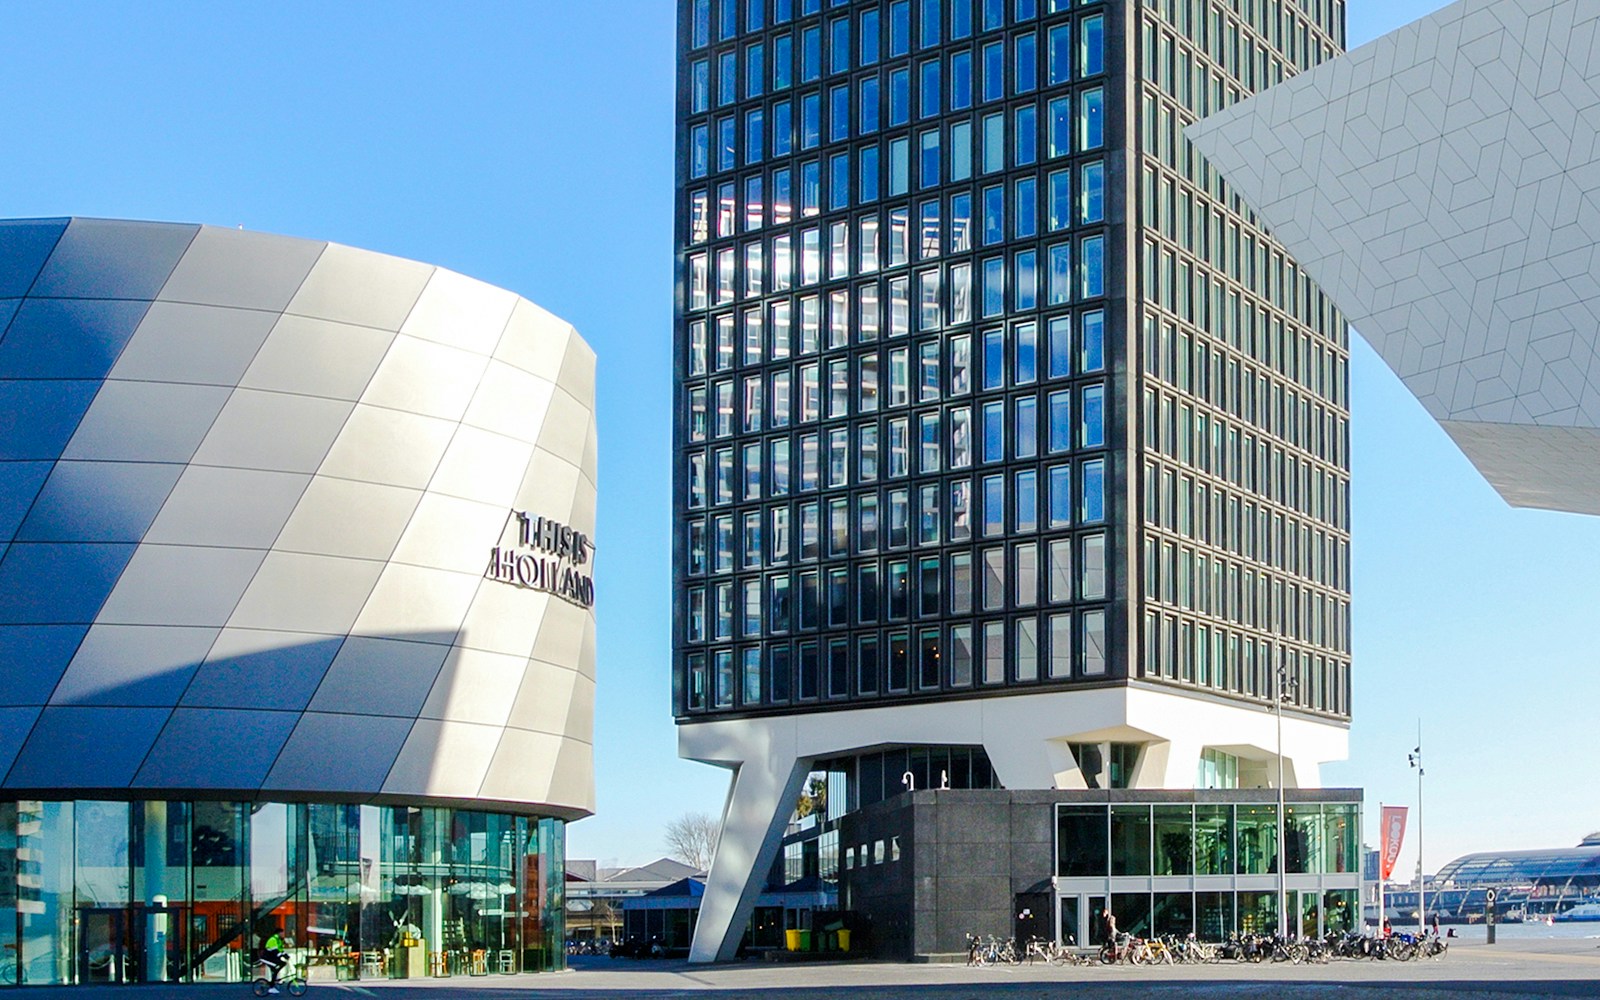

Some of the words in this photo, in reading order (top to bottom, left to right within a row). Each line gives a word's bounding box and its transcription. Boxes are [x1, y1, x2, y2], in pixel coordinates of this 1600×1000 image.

[516, 511, 572, 557] THIS
[571, 531, 587, 564] IS
[490, 547, 594, 606] HOLLAND
